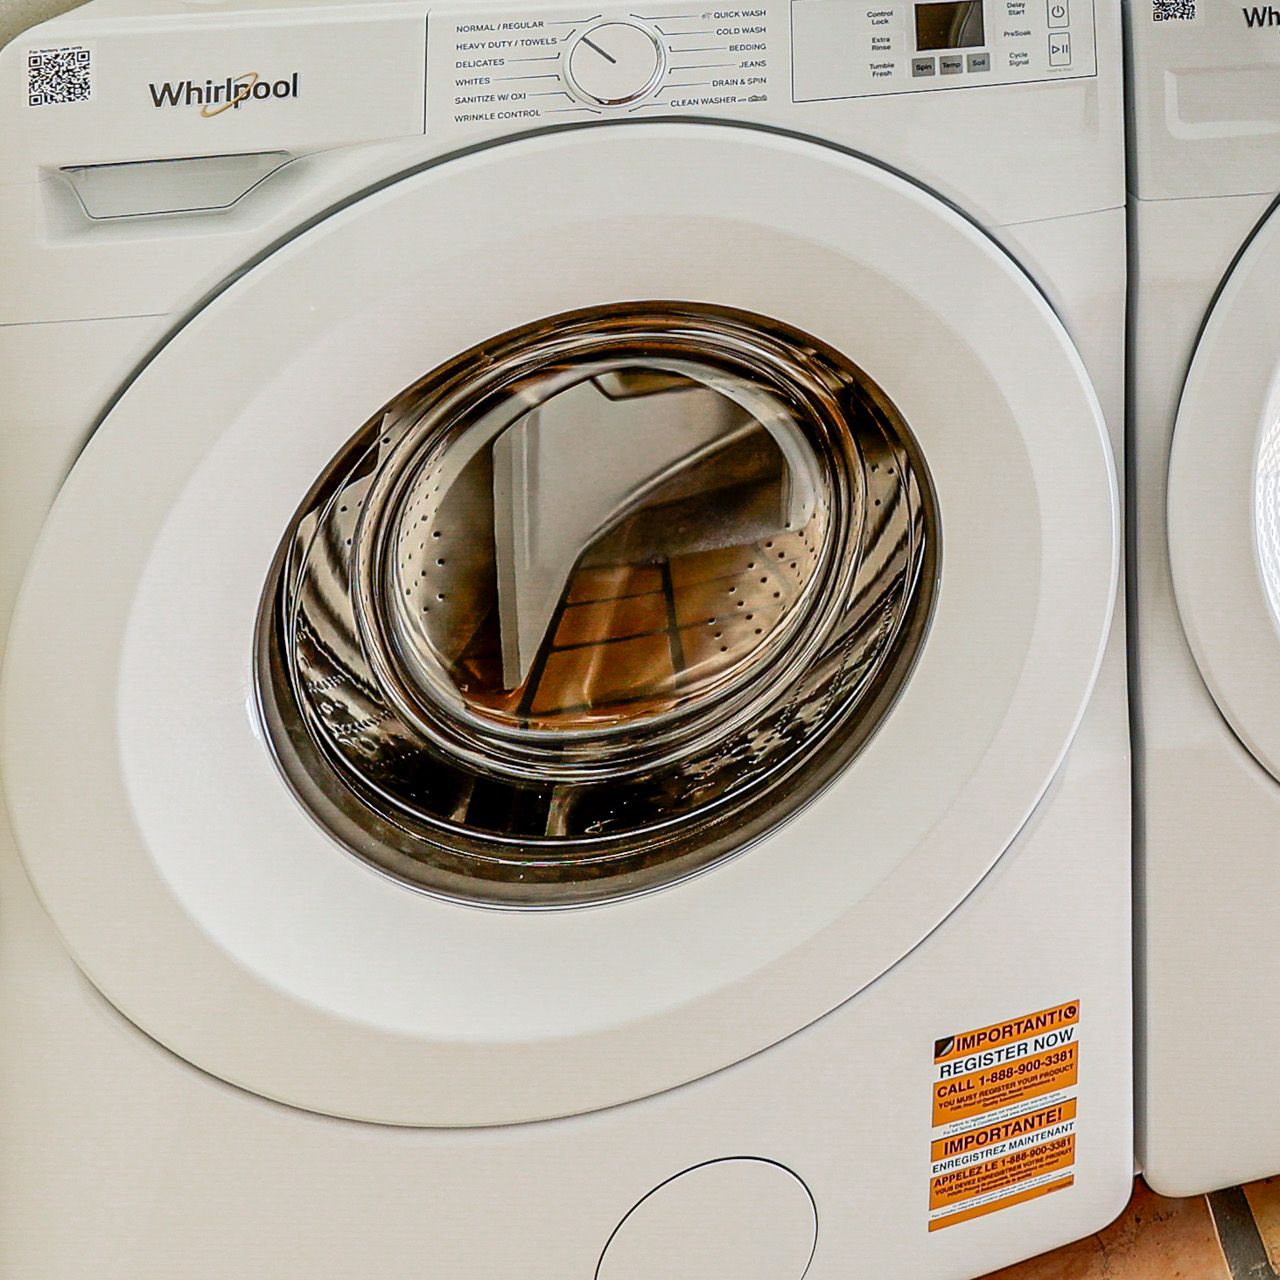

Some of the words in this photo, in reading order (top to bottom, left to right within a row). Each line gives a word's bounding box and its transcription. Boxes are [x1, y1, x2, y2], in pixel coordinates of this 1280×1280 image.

[714, 11, 740, 19] QUICK
[867, 10, 893, 18] Control
[456, 24, 495, 33] NORMAL
[502, 21, 544, 30] REGULAR
[456, 42, 486, 50] HEAVY
[488, 41, 512, 49] DUTY
[519, 38, 557, 47] TOWELS
[729, 43, 767, 51] BEDDING
[1009, 51, 1028, 59] Cycle
[456, 58, 505, 68] DELICATES
[739, 60, 767, 68] JEANS
[915, 63, 932, 71] Spin
[942, 62, 961, 70] Temp
[1009, 59, 1029, 67] Signal
[872, 69, 892, 77] Fresh
[455, 77, 490, 86] WHITES
[712, 79, 738, 87] DRAIN
[150, 72, 299, 109] Whirlpool
[455, 95, 495, 104] SANITIZE
[670, 98, 698, 107] CLEAN
[700, 96, 736, 104] WASHER
[455, 112, 496, 122] WRINKLE
[498, 109, 541, 119] CONTROL
[956, 1009, 1062, 1051] IMPORTANT!
[940, 1042, 1028, 1079] REGISTER
[1033, 1027, 1074, 1052] NOW
[937, 1079, 975, 1098] CALL
[978, 1049, 1073, 1086] 1-888-900-3381
[938, 1099, 955, 1109] YOU
[956, 1092, 977, 1104] MUST
[979, 1081, 1016, 1098] REGISTER
[1017, 1075, 1038, 1086] YOUR
[1039, 1063, 1073, 1080] PRODUCT
[944, 1107, 1062, 1156] IMPORTANTE!
[932, 1145, 1006, 1173] ENREGISTREZ
[1008, 1122, 1074, 1150] MAINTENANT
[934, 1165, 982, 1188] APPELEZ
[985, 1161, 998, 1172] LE
[1001, 1137, 1071, 1167] 1-888-900-3381
[935, 1185, 953, 1195] VOUS
[954, 1178, 976, 1189] DEVEZ
[977, 1164, 1021, 1183] ENREGISTRER
[1022, 1156, 1044, 1168] VOTRE
[1045, 1147, 1072, 1160] PRODUIT
